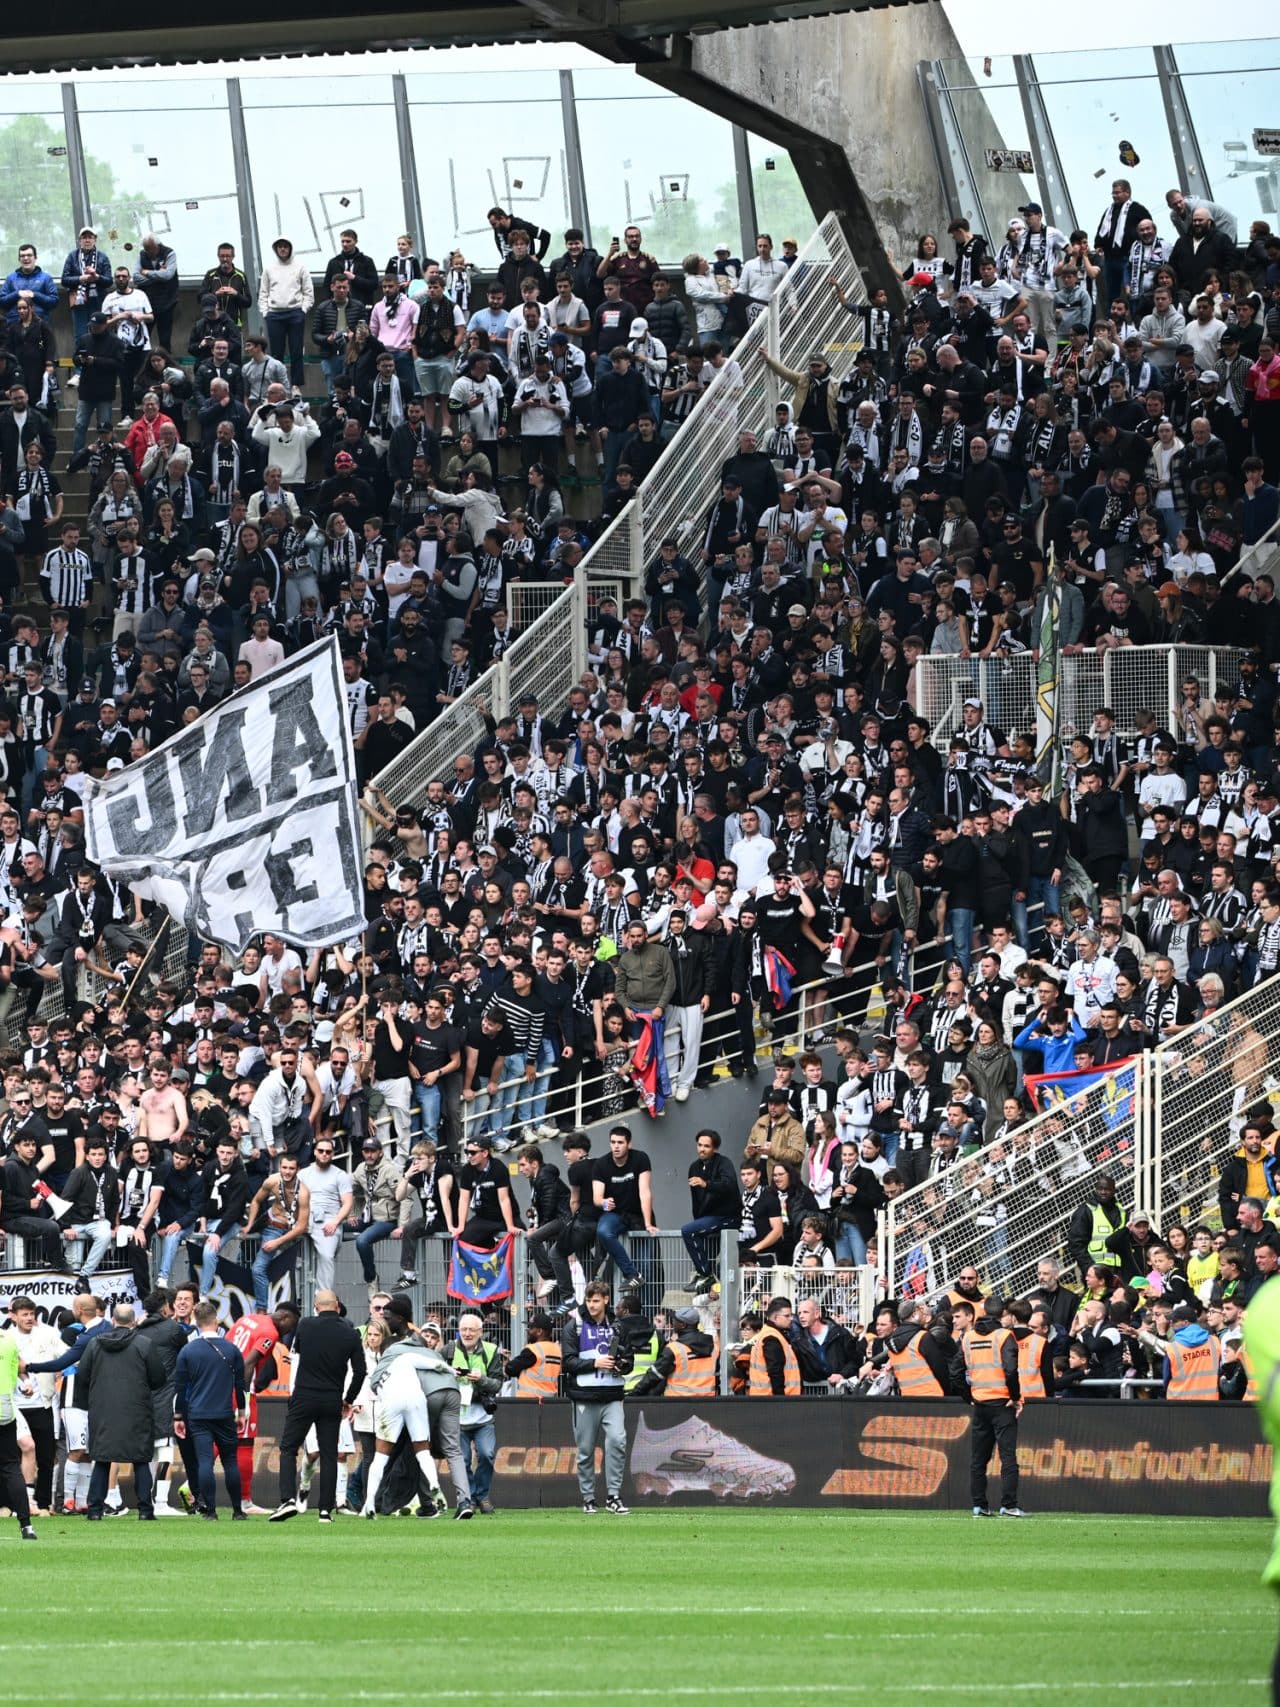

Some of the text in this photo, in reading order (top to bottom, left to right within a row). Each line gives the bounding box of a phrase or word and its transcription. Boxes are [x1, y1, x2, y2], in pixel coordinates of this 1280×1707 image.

[0, 1281, 81, 1297] SUPPORTERS
[587, 1328, 614, 1341] LFP
[1181, 1349, 1212, 1363] STADIER
